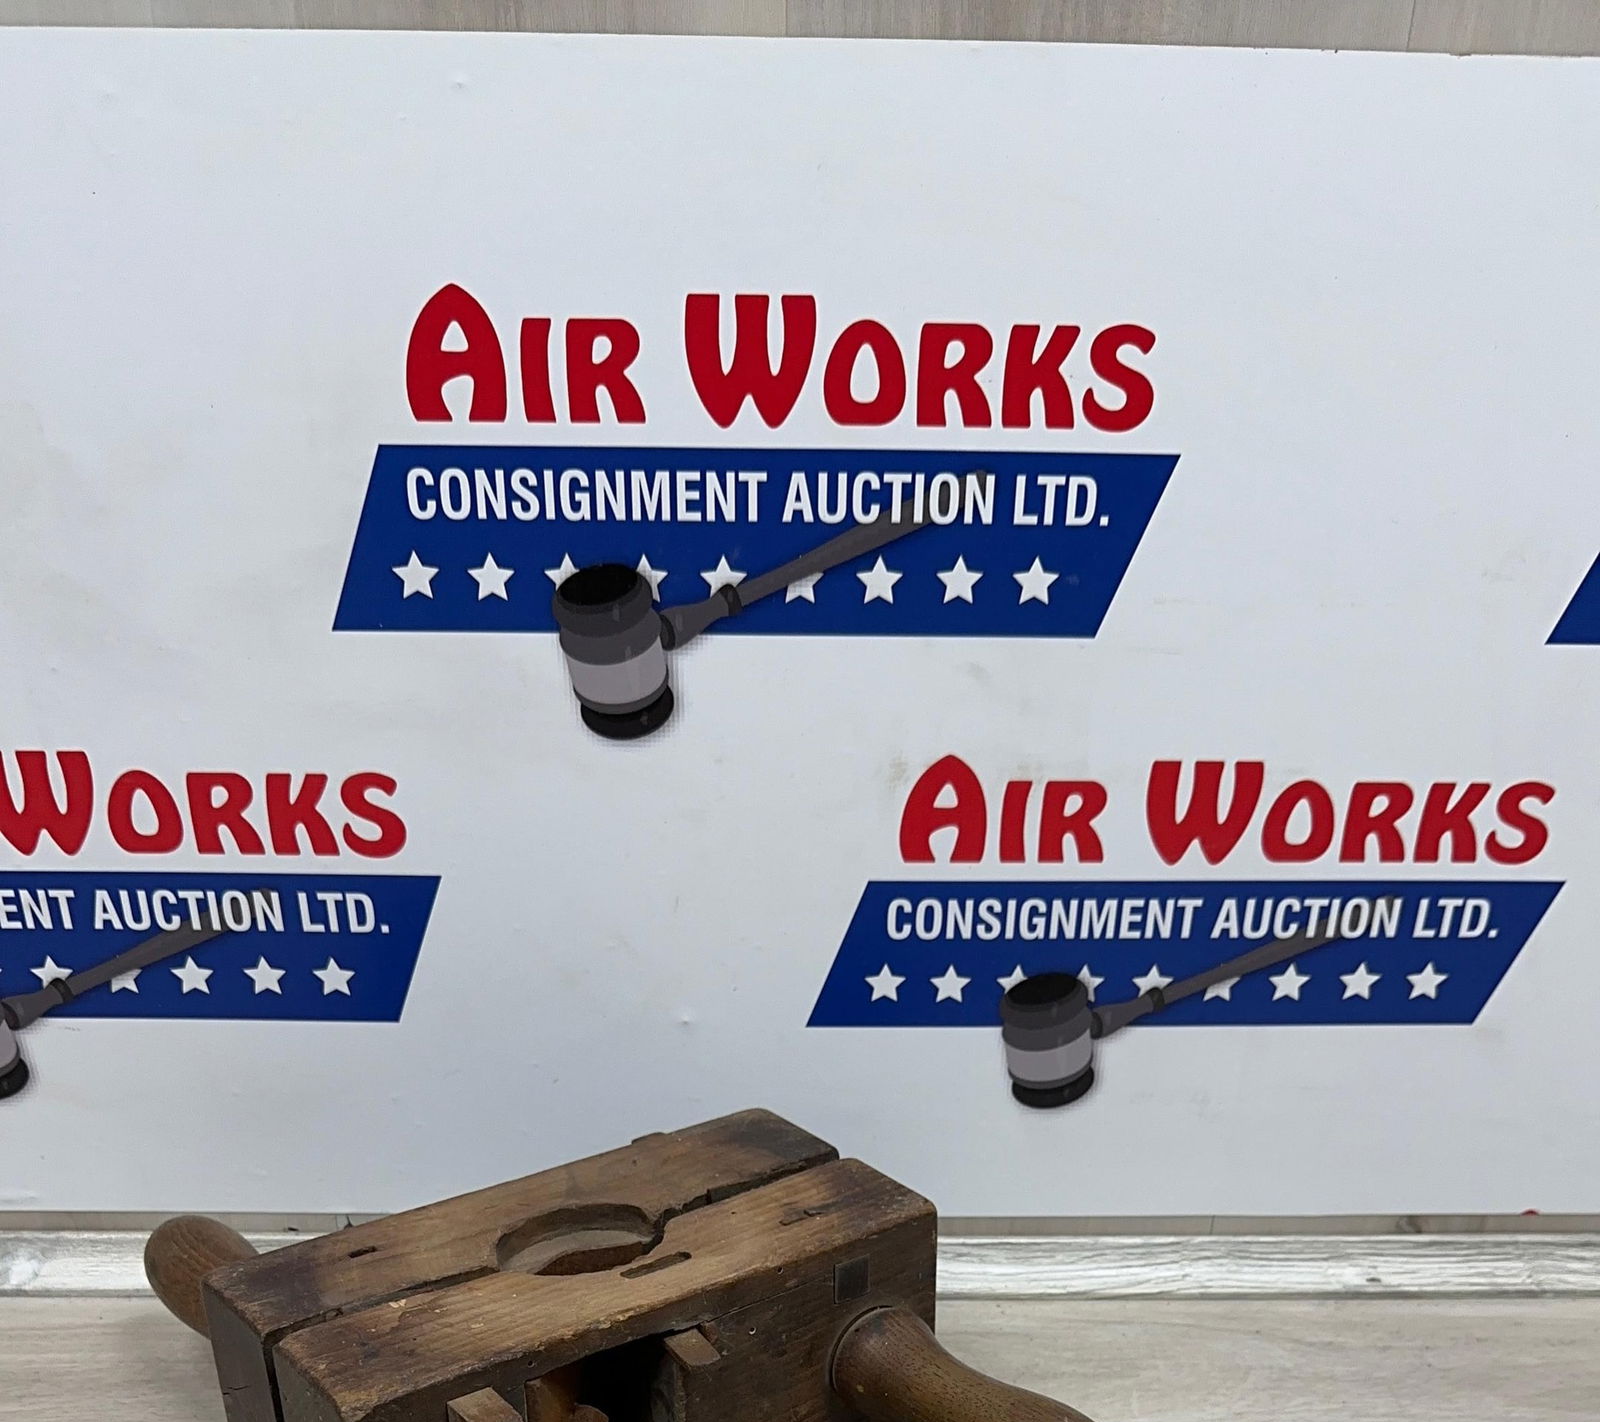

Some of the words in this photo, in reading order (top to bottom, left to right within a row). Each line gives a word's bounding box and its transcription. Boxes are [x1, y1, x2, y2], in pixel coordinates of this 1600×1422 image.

[406, 285, 644, 424] AIR
[685, 293, 1154, 433] WORKS
[406, 467, 768, 522] CONSIGNMENT
[782, 471, 996, 525] AUCTION
[1013, 474, 1109, 527] LTD.
[0, 752, 406, 858] WORKS
[899, 755, 1107, 863] AIR
[1147, 760, 1553, 865] WORKS
[94, 889, 285, 932] AUCTION
[297, 892, 390, 933] LTD.
[887, 898, 1204, 940] CONSIGNMENT
[1210, 897, 1403, 939] AUCTION
[1412, 898, 1498, 938] LTD.
